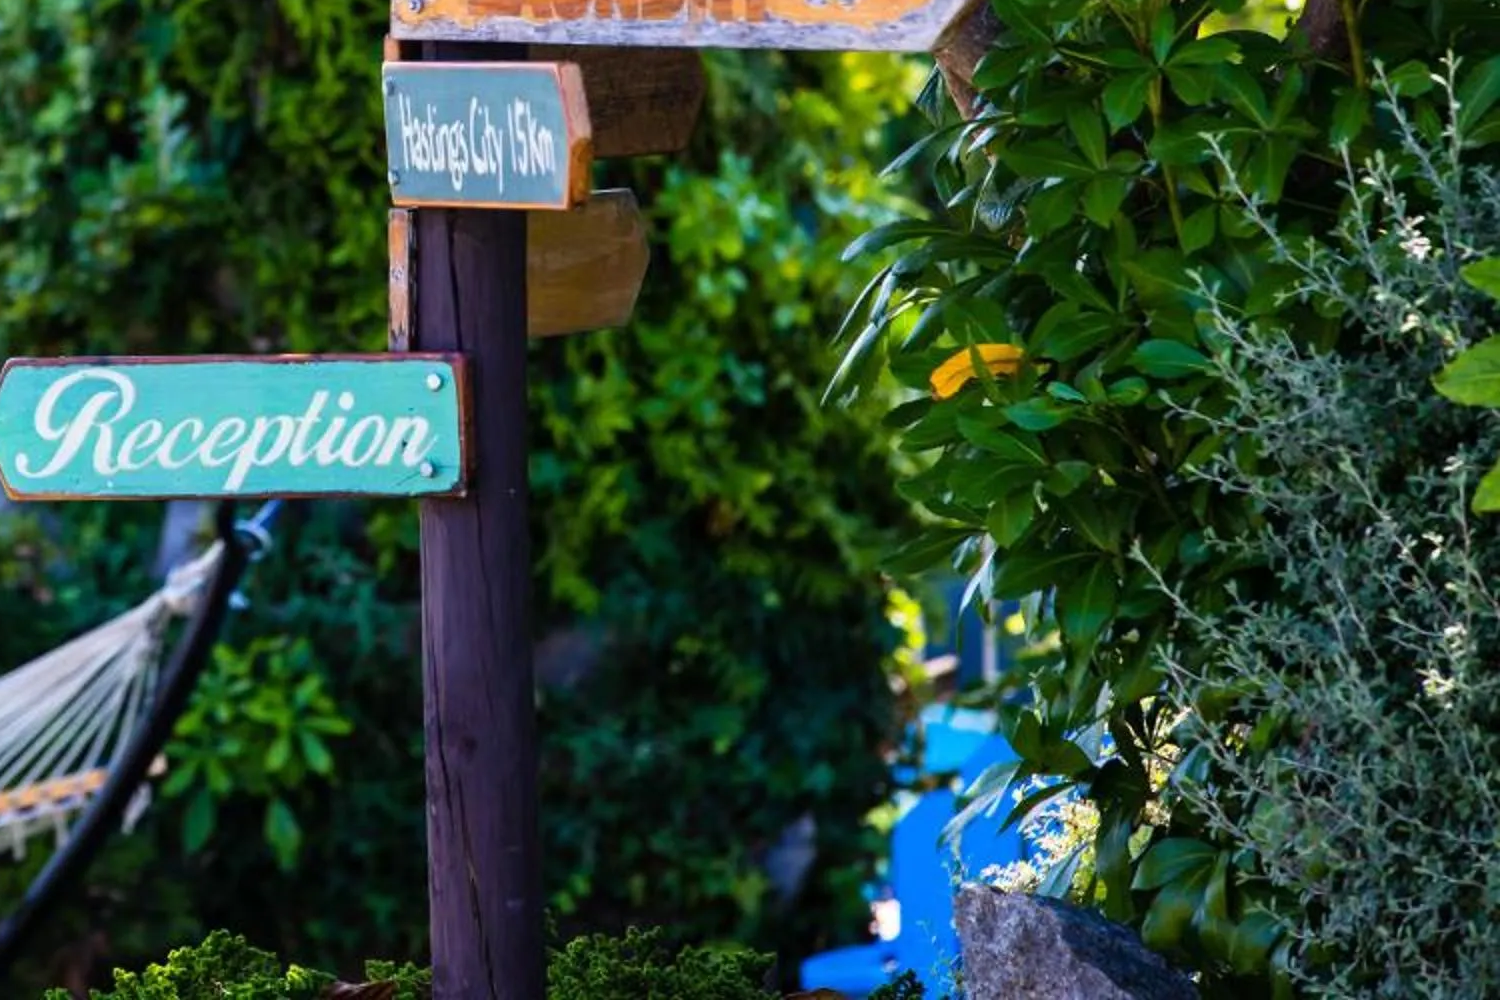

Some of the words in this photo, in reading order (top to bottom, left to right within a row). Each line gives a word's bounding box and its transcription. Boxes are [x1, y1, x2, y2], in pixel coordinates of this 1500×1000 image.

[399, 93, 468, 191] Hastings
[469, 97, 503, 193] City
[16, 369, 438, 492] Reception
